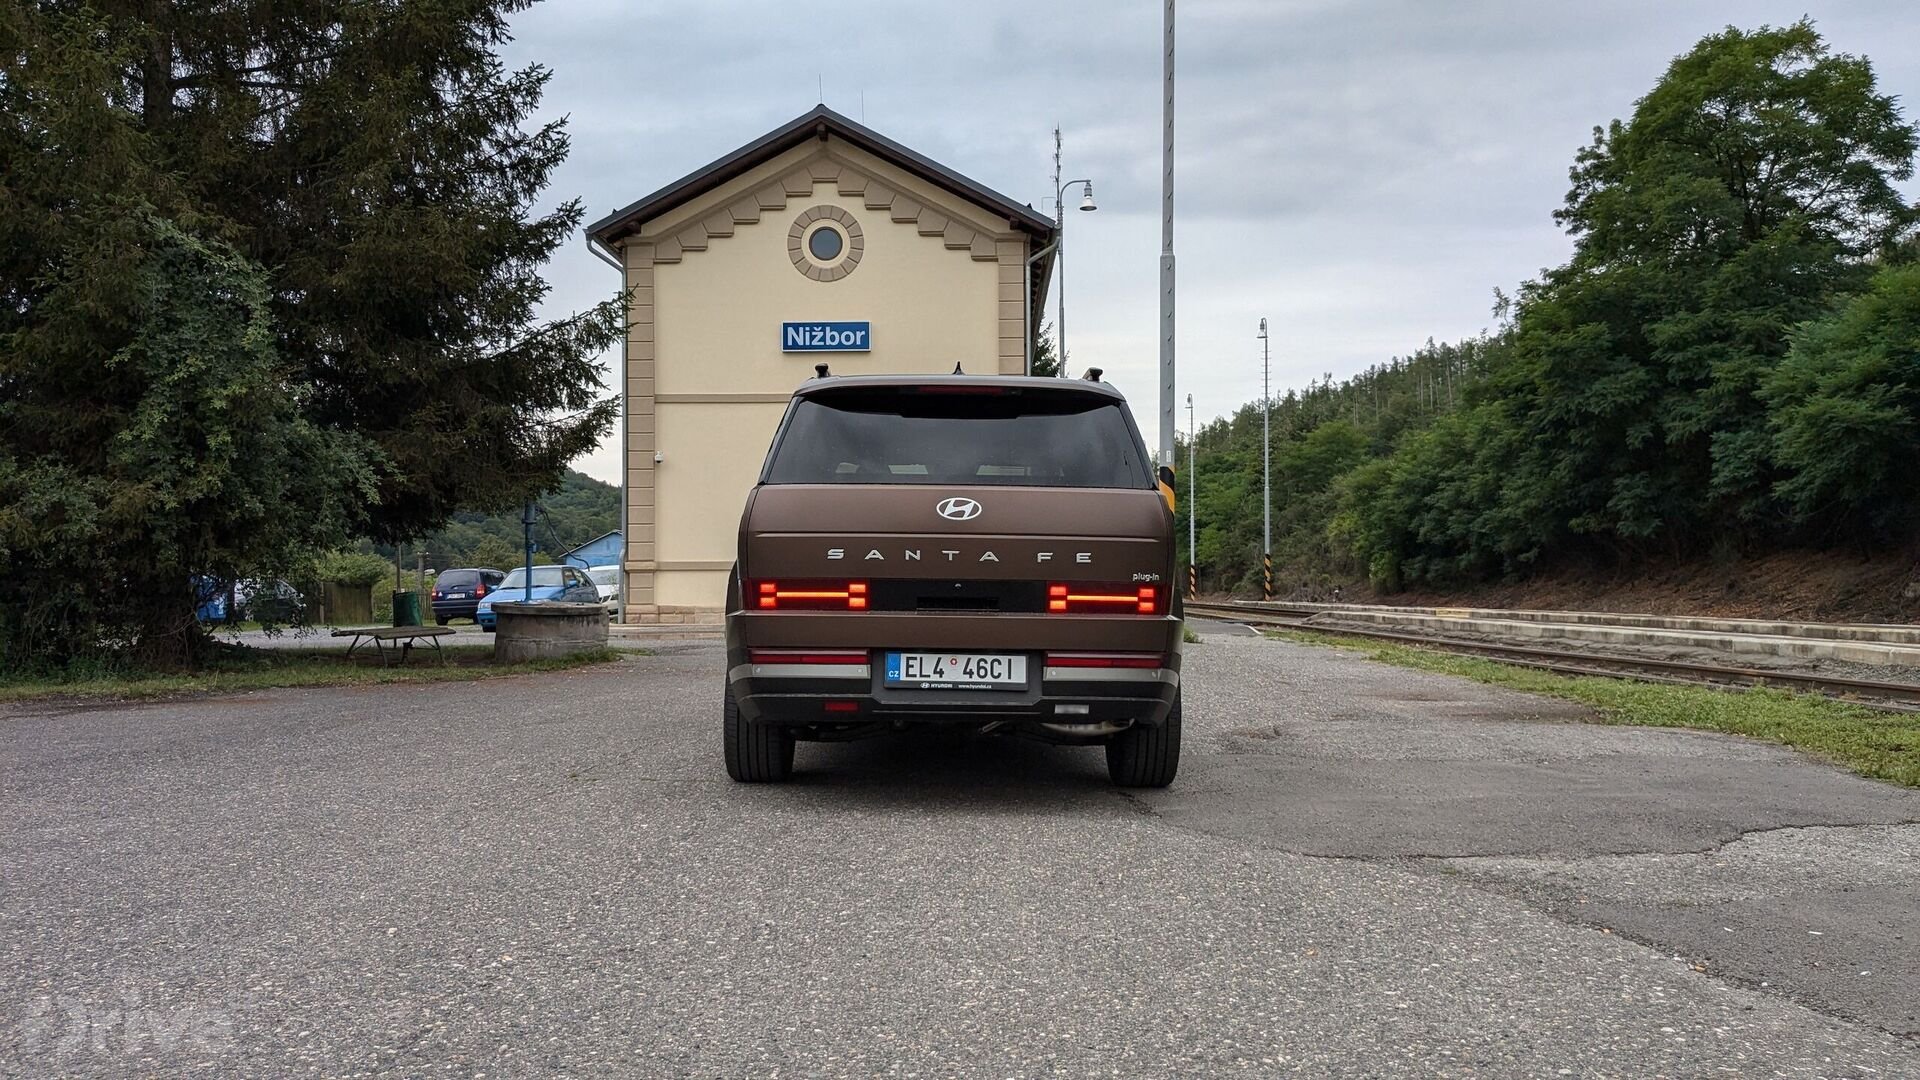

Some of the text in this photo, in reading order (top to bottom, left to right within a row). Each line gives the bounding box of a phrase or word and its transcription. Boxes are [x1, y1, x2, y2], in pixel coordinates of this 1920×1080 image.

[787, 326, 866, 346] Nižbor
[826, 548, 1092, 563] SANTA FE
[1132, 572, 1160, 582] plug-in
[888, 670, 899, 678] CZ
[905, 656, 945, 679] EL4
